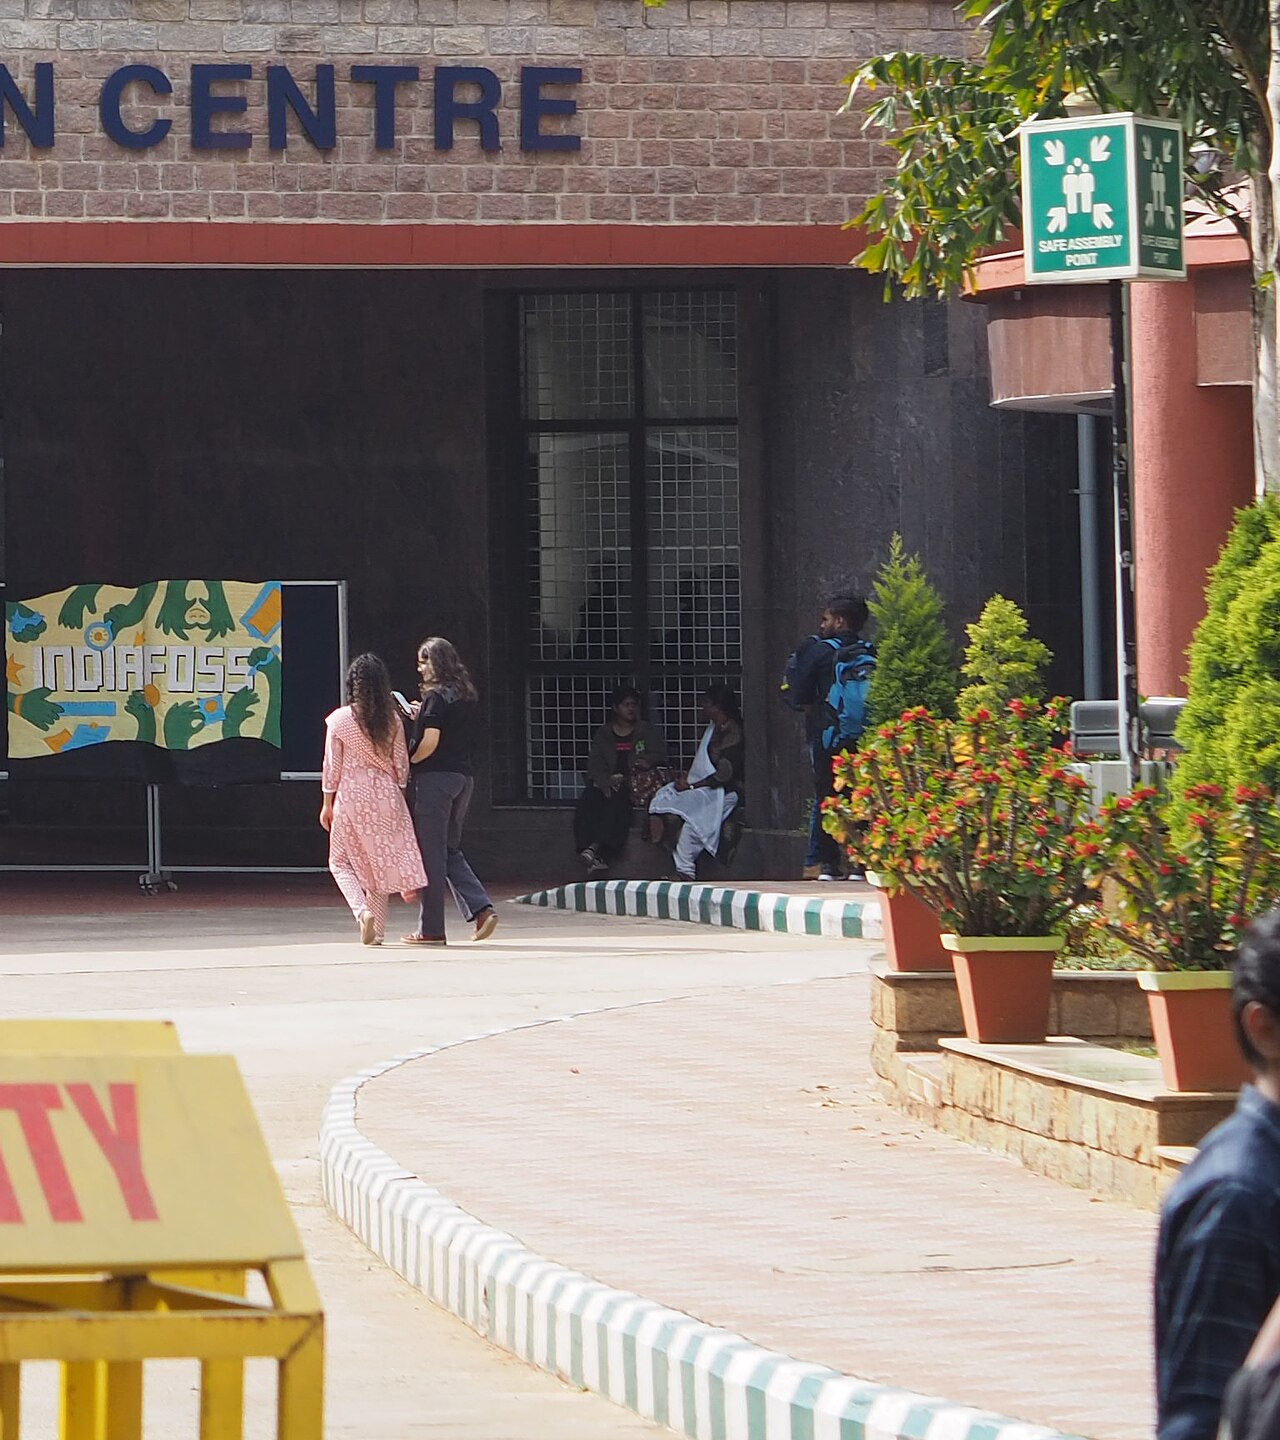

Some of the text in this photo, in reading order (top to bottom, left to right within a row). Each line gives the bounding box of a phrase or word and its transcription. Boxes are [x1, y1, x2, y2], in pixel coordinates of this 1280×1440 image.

[99, 63, 582, 151] CENTRE
[1038, 235, 1123, 252] SAFE ASSEMBLY
[1065, 253, 1098, 266] POINT
[32, 645, 255, 693] INDIAFOSS
